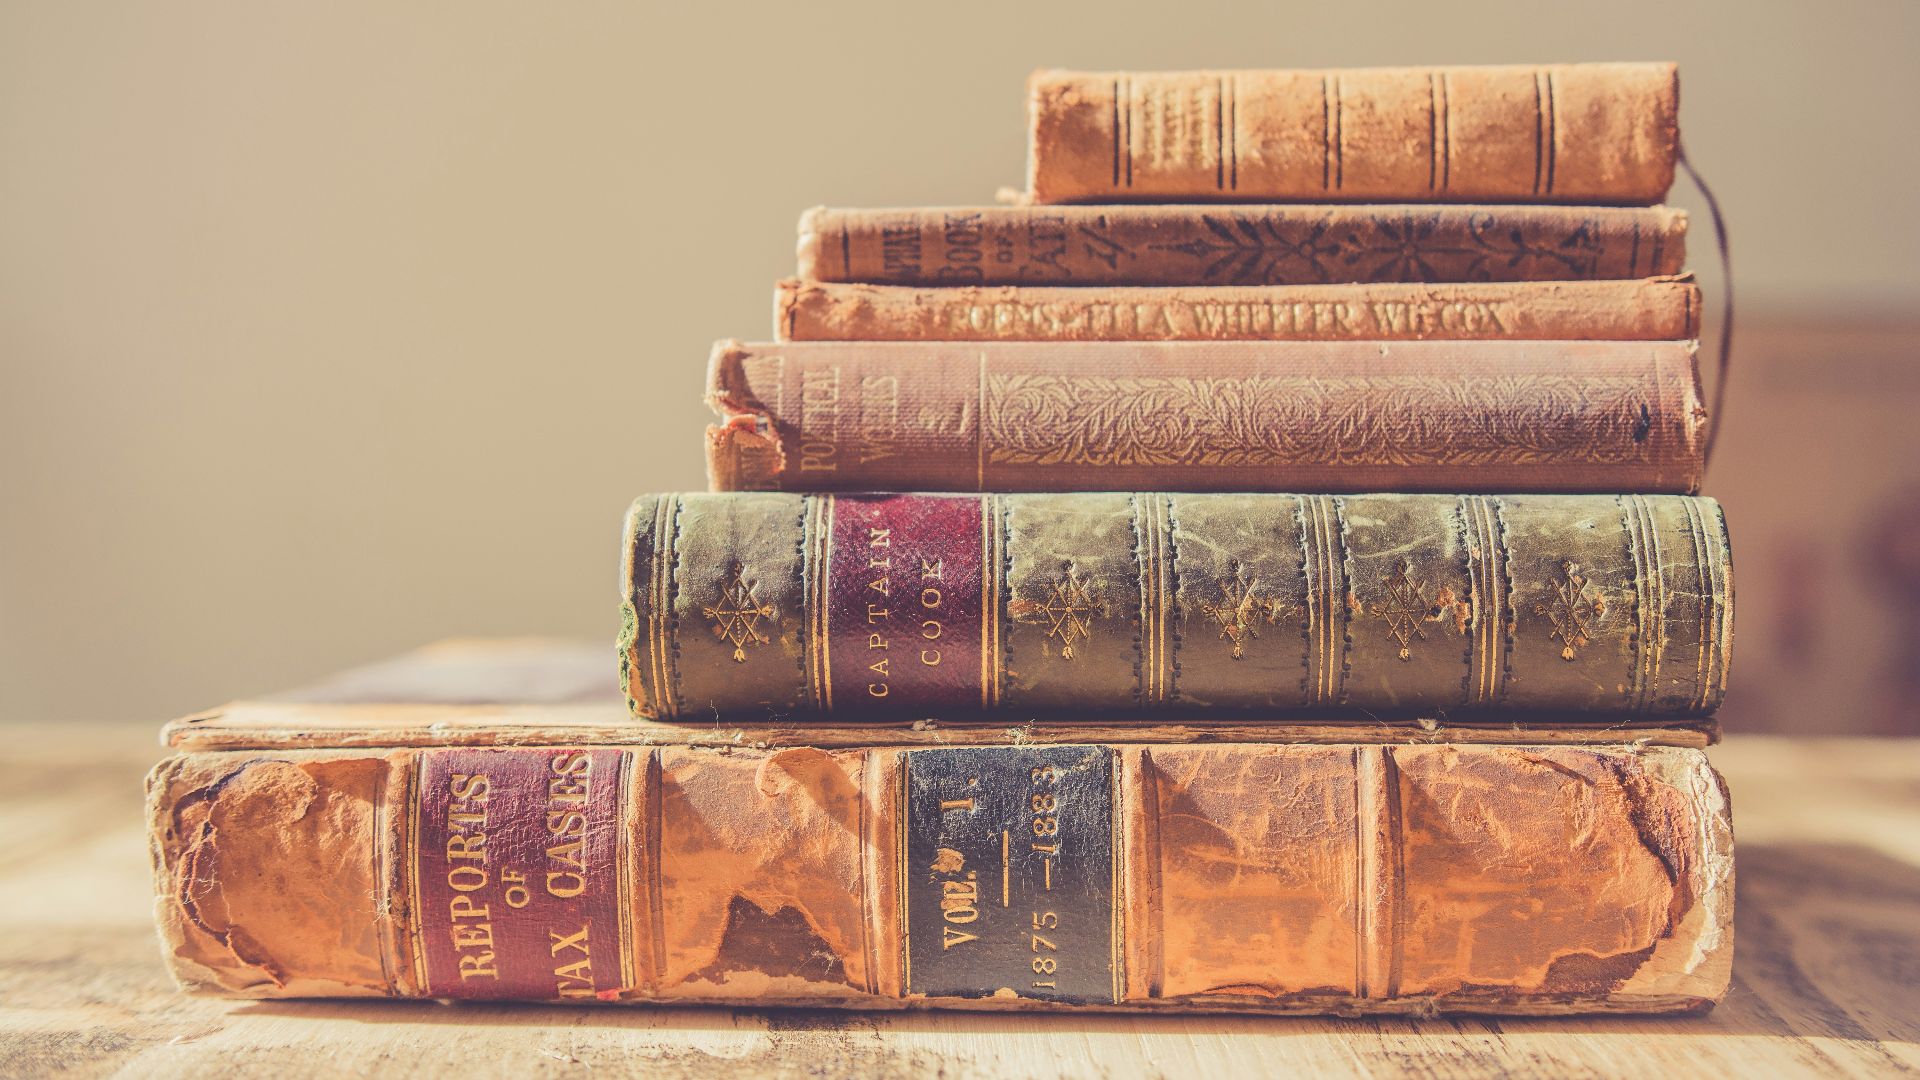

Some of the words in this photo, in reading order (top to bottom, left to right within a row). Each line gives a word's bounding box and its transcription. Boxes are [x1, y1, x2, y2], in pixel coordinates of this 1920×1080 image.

[936, 213, 983, 280] BOOK
[996, 234, 1014, 265] OF
[799, 365, 840, 472] POETICAL
[860, 375, 898, 464] WORKS
[867, 527, 891, 698] CAPTAIN
[921, 558, 942, 667] COOK
[545, 752, 592, 899] CASES
[446, 772, 499, 981] REPORTS
[500, 864, 531, 909] OF
[940, 869, 979, 950] VOL.
[548, 924, 596, 998] TAX
[1031, 910, 1058, 990] 1875
